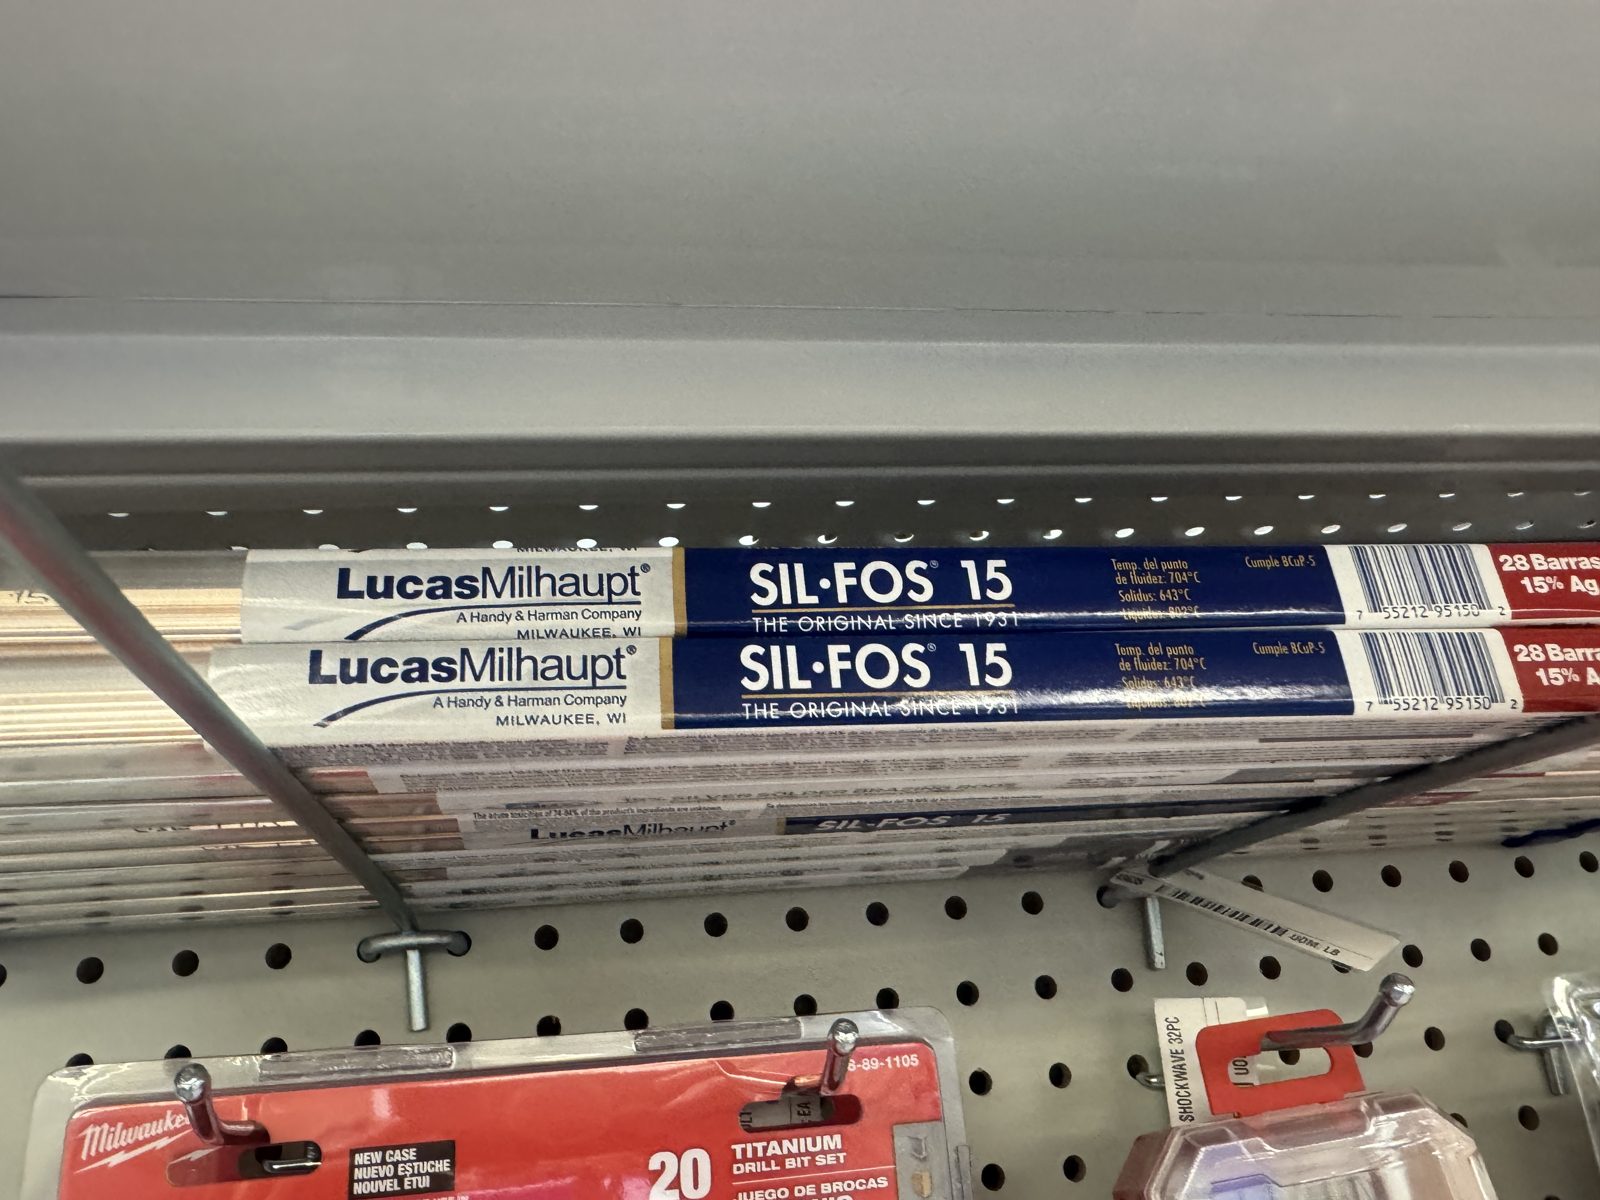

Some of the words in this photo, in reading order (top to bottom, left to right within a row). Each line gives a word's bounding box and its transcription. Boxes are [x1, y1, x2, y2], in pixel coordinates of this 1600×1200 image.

[1111, 558, 1141, 572] Temp.
[1143, 557, 1158, 570] del
[1161, 559, 1188, 573] punto
[1245, 556, 1280, 569] Cumple
[1281, 555, 1316, 568] BCuP-5
[1499, 554, 1531, 571] 28
[1531, 553, 1600, 570] Barras
[960, 559, 1013, 601] 15
[1116, 573, 1127, 585] de
[1168, 571, 1201, 584] 704°C
[1520, 575, 1565, 594] 15%
[1570, 575, 1600, 596] Ag
[1118, 589, 1157, 602] Solidus:
[1159, 588, 1191, 601] 643°C
[456, 612, 468, 623] A
[470, 611, 512, 624] Handy
[514, 610, 525, 621] &
[528, 610, 578, 622] Harman
[581, 609, 642, 622] Company
[1355, 610, 1363, 620] 7
[1382, 606, 1429, 619] 55212
[1434, 603, 1480, 618] 95150
[1497, 606, 1506, 616] 2
[752, 617, 788, 633] THE
[798, 614, 897, 632] ORIGINAL
[904, 613, 963, 629] SINCE
[974, 612, 1020, 628] 1931
[517, 628, 617, 639] MILWAUKEE,
[623, 627, 642, 638] WI
[1147, 642, 1163, 655] del
[1166, 643, 1195, 658] punto
[1252, 642, 1288, 656] Cumple
[1514, 643, 1546, 661] 28
[1546, 643, 1600, 661] Barr
[959, 642, 1013, 687] 15
[1119, 658, 1131, 671] de
[1174, 657, 1207, 670] 704°C
[1535, 667, 1581, 686] 15%
[433, 697, 444, 708] A
[447, 696, 491, 711] Handy
[495, 696, 504, 707] &
[507, 695, 560, 708] Harman
[563, 693, 627, 708] Company
[741, 703, 780, 720] THE
[789, 701, 892, 718] ORIGINAL
[900, 700, 960, 717] SINCE
[1365, 701, 1373, 711] 7
[1392, 697, 1439, 711] 55212
[1446, 696, 1492, 710] 95150
[1510, 699, 1518, 710] 2
[495, 713, 601, 727] MILWAUKEE,
[606, 712, 627, 724] WI
[1164, 1016, 1184, 1046] 32PC
[1169, 1046, 1196, 1123] SHOCKWAVE
[731, 1134, 843, 1160] TITANIUM
[354, 1150, 383, 1166] NEW
[385, 1148, 417, 1163] CASE
[732, 1157, 781, 1176] DRILL
[785, 1155, 813, 1170] BIT
[815, 1152, 847, 1168] SET
[353, 1164, 395, 1180] NUEVO
[397, 1159, 452, 1177] ESTUCHE
[648, 1147, 712, 1200] 20
[353, 1179, 401, 1195] NOUVEL
[736, 1187, 790, 1200] JUEGO
[794, 1182, 819, 1197] DE
[821, 1176, 889, 1194] BROCAS
